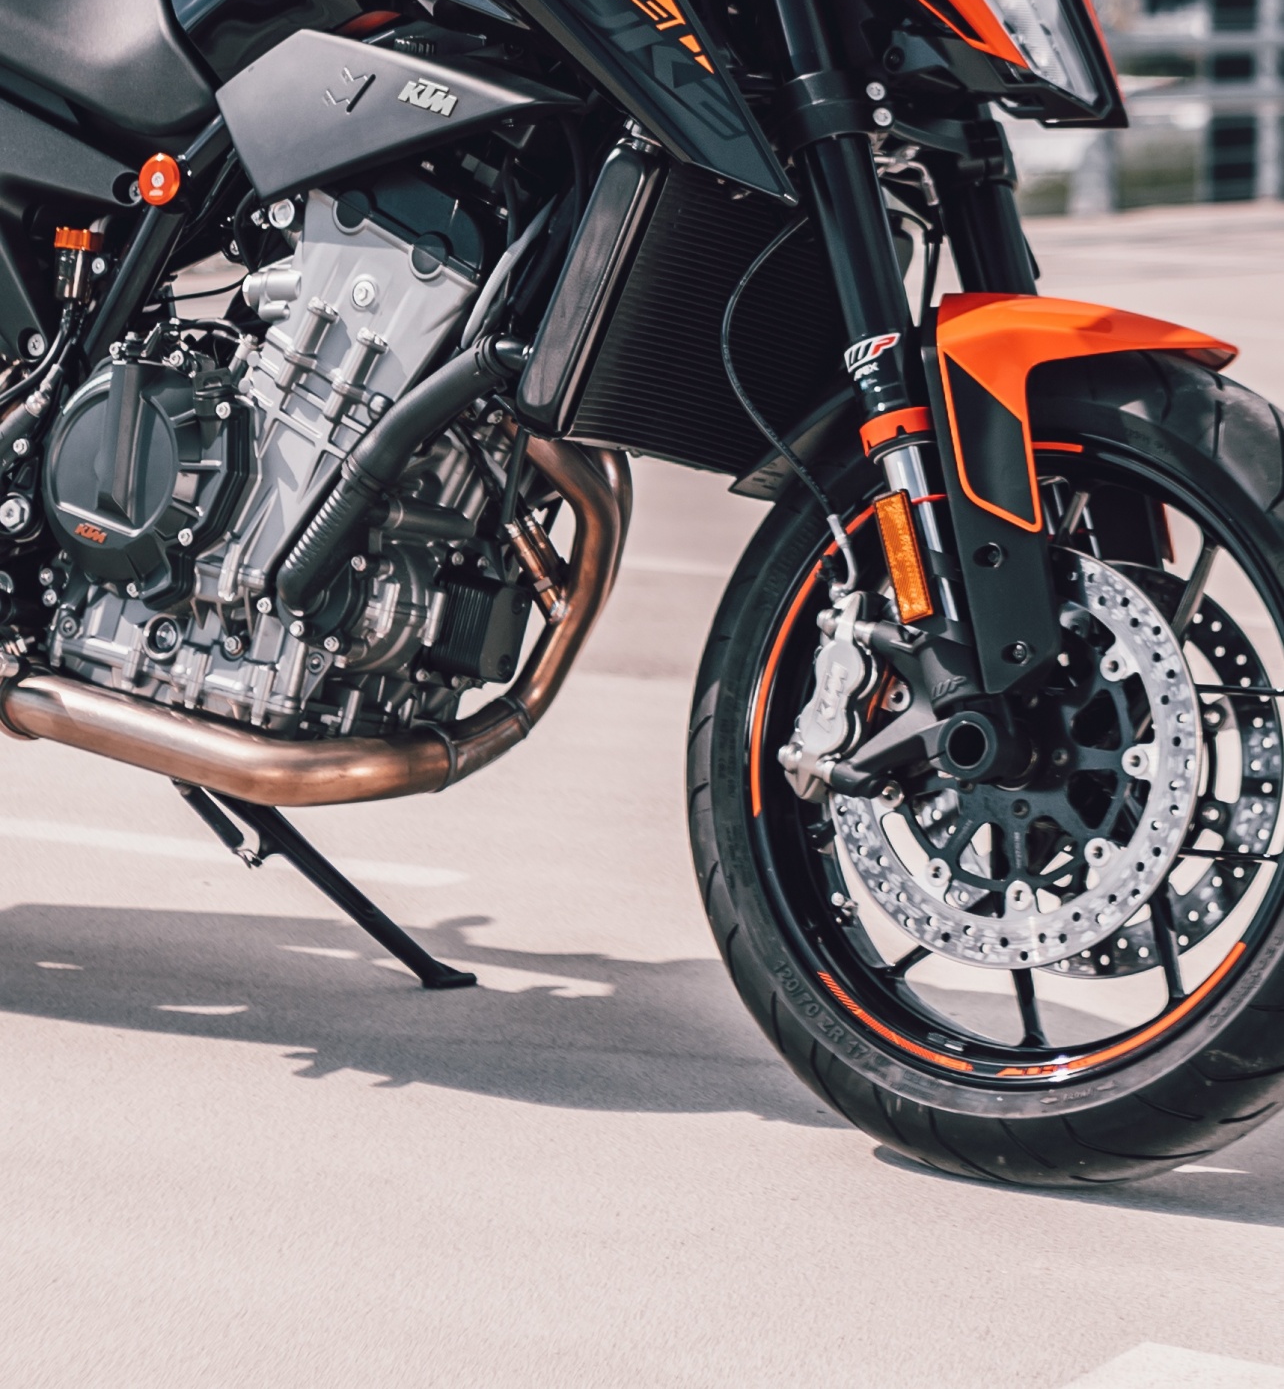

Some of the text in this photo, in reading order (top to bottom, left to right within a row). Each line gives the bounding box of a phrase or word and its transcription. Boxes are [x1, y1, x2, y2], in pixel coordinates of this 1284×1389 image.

[397, 77, 458, 117] KTM
[74, 522, 107, 544] KTM
[816, 661, 848, 733] KTM
[773, 960, 820, 1018] 120/70
[817, 1014, 845, 1043] ZR
